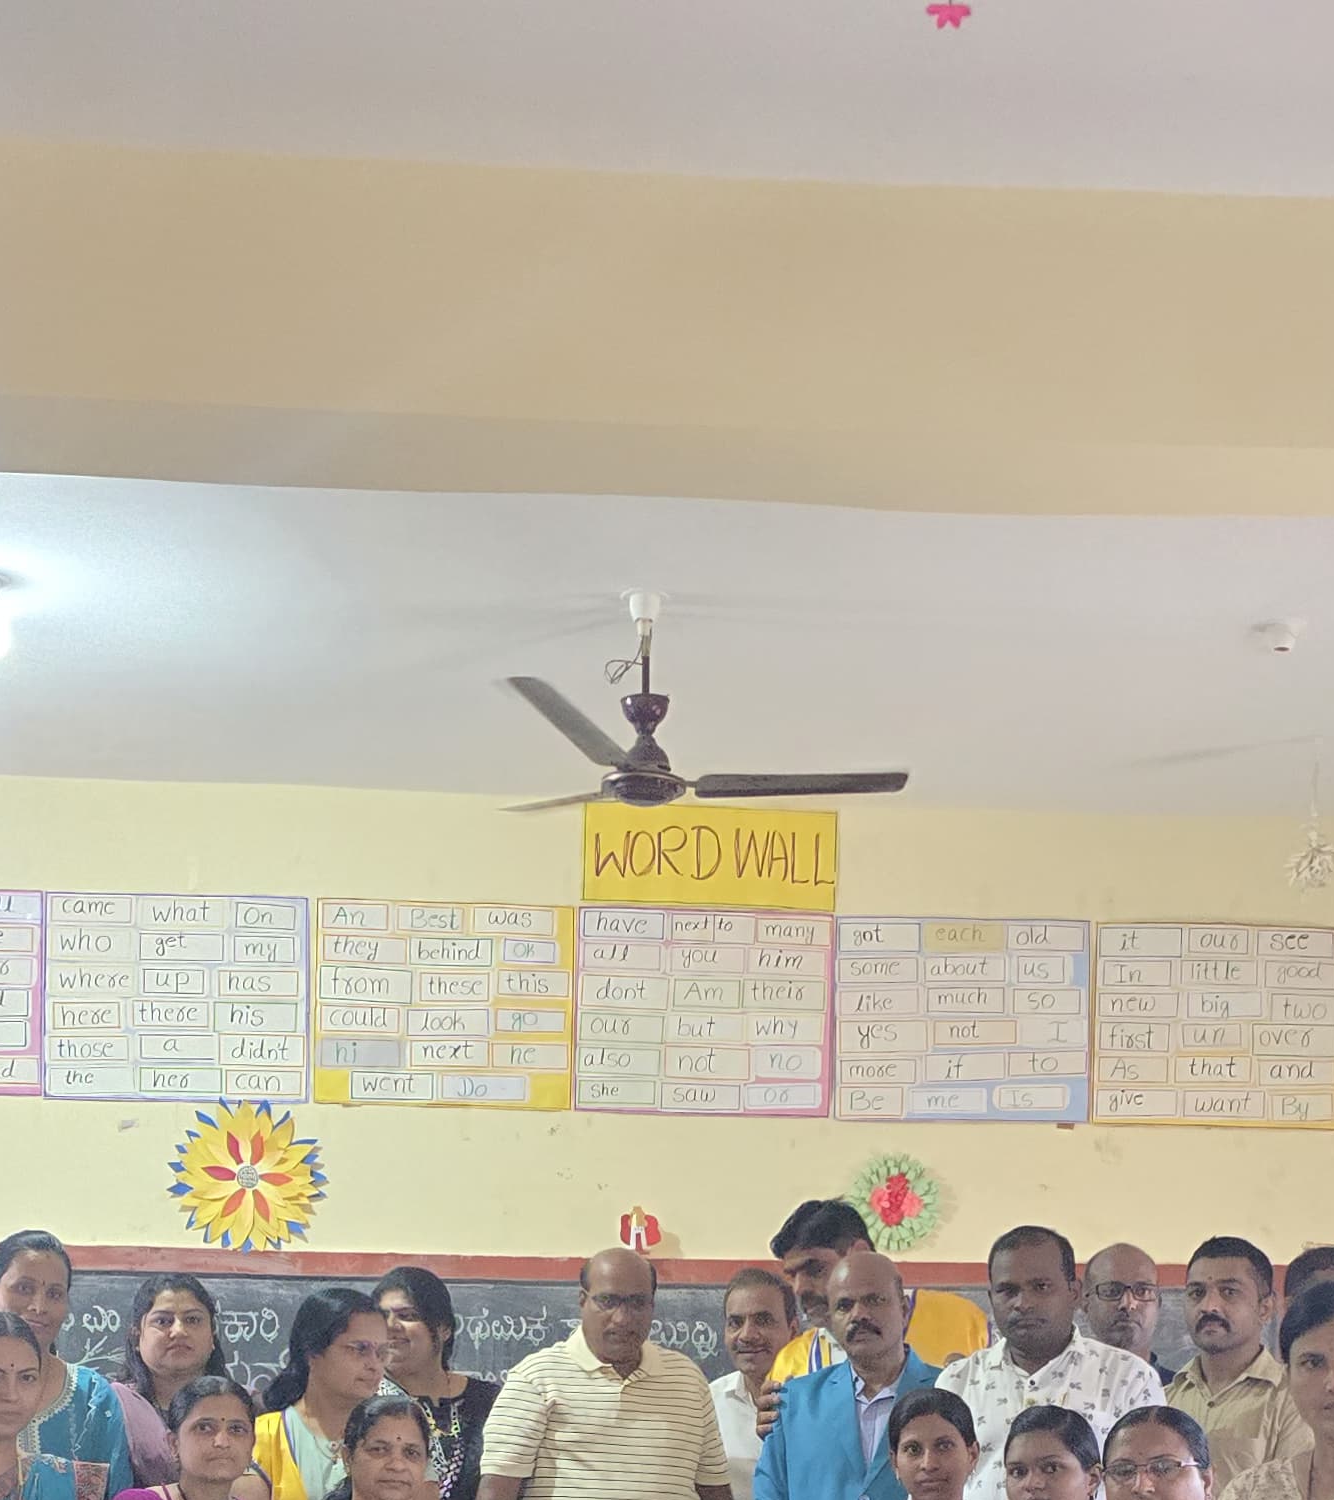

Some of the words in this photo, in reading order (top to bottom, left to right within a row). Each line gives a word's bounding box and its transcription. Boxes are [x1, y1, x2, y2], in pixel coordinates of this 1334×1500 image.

[594, 825, 722, 881] WORD
[734, 827, 835, 887] WALL
[62, 898, 116, 915] came
[152, 900, 210, 922] what
[243, 906, 274, 925] On
[332, 907, 366, 926] An
[410, 908, 459, 930] Best
[488, 911, 532, 928] was
[596, 912, 648, 935] have
[674, 916, 710, 931] next
[718, 917, 733, 931] to
[60, 928, 112, 952] who
[764, 923, 815, 944] many
[852, 926, 884, 946] got
[935, 925, 986, 942] each
[1016, 928, 1051, 946] old
[1120, 931, 1140, 952] it
[1199, 932, 1239, 950] our
[1269, 932, 1311, 951] see
[155, 933, 187, 957] get
[244, 942, 277, 962] my
[333, 935, 379, 960] they
[418, 940, 481, 960] behind
[593, 945, 630, 962] all
[682, 948, 718, 968] you
[758, 950, 804, 970] him
[930, 958, 988, 976] about
[58, 968, 130, 989] where
[850, 960, 901, 977] some
[1023, 963, 1050, 979] us
[1116, 963, 1142, 984] In
[1190, 961, 1242, 981] little
[1277, 963, 1323, 984] good
[155, 971, 190, 993] up
[228, 972, 272, 991] has
[331, 967, 390, 995] from
[428, 977, 483, 996] these
[507, 973, 549, 994] this
[751, 981, 805, 1001] their
[683, 982, 724, 1002] Am
[938, 988, 988, 1006] much
[138, 1002, 199, 1022] there
[855, 994, 894, 1013] like
[1110, 996, 1157, 1012] new
[1201, 994, 1230, 1018] big
[1283, 1001, 1328, 1020] two
[61, 1006, 114, 1025] here
[230, 1003, 265, 1027] his
[329, 1007, 388, 1028] could
[420, 1012, 466, 1032] look
[511, 1013, 538, 1030] go
[590, 1017, 631, 1035] our
[677, 1016, 716, 1037] but
[756, 1017, 798, 1037] why
[858, 1022, 898, 1049] yes
[949, 1020, 980, 1040] not
[1048, 1021, 1069, 1043] I
[163, 1038, 179, 1052] a
[1109, 1024, 1154, 1050] first
[1259, 1029, 1314, 1047] over
[57, 1039, 114, 1058] those
[335, 1041, 358, 1065] hi
[422, 1041, 475, 1060] next
[583, 1049, 632, 1068] also
[678, 1048, 716, 1073] not
[769, 1052, 803, 1072] no
[849, 1062, 897, 1078] more
[945, 1054, 964, 1079] if
[1028, 1052, 1059, 1073] to
[1110, 1058, 1140, 1080] As
[1189, 1055, 1237, 1077] that
[1269, 1061, 1315, 1079] and
[153, 1071, 189, 1088] her
[235, 1073, 281, 1092] can
[362, 1076, 415, 1093] went
[672, 1087, 716, 1103] saw
[850, 1091, 885, 1111] Be
[927, 1093, 960, 1108] me
[1109, 1089, 1144, 1112] give
[1194, 1093, 1251, 1113] want
[1281, 1096, 1310, 1120] By
